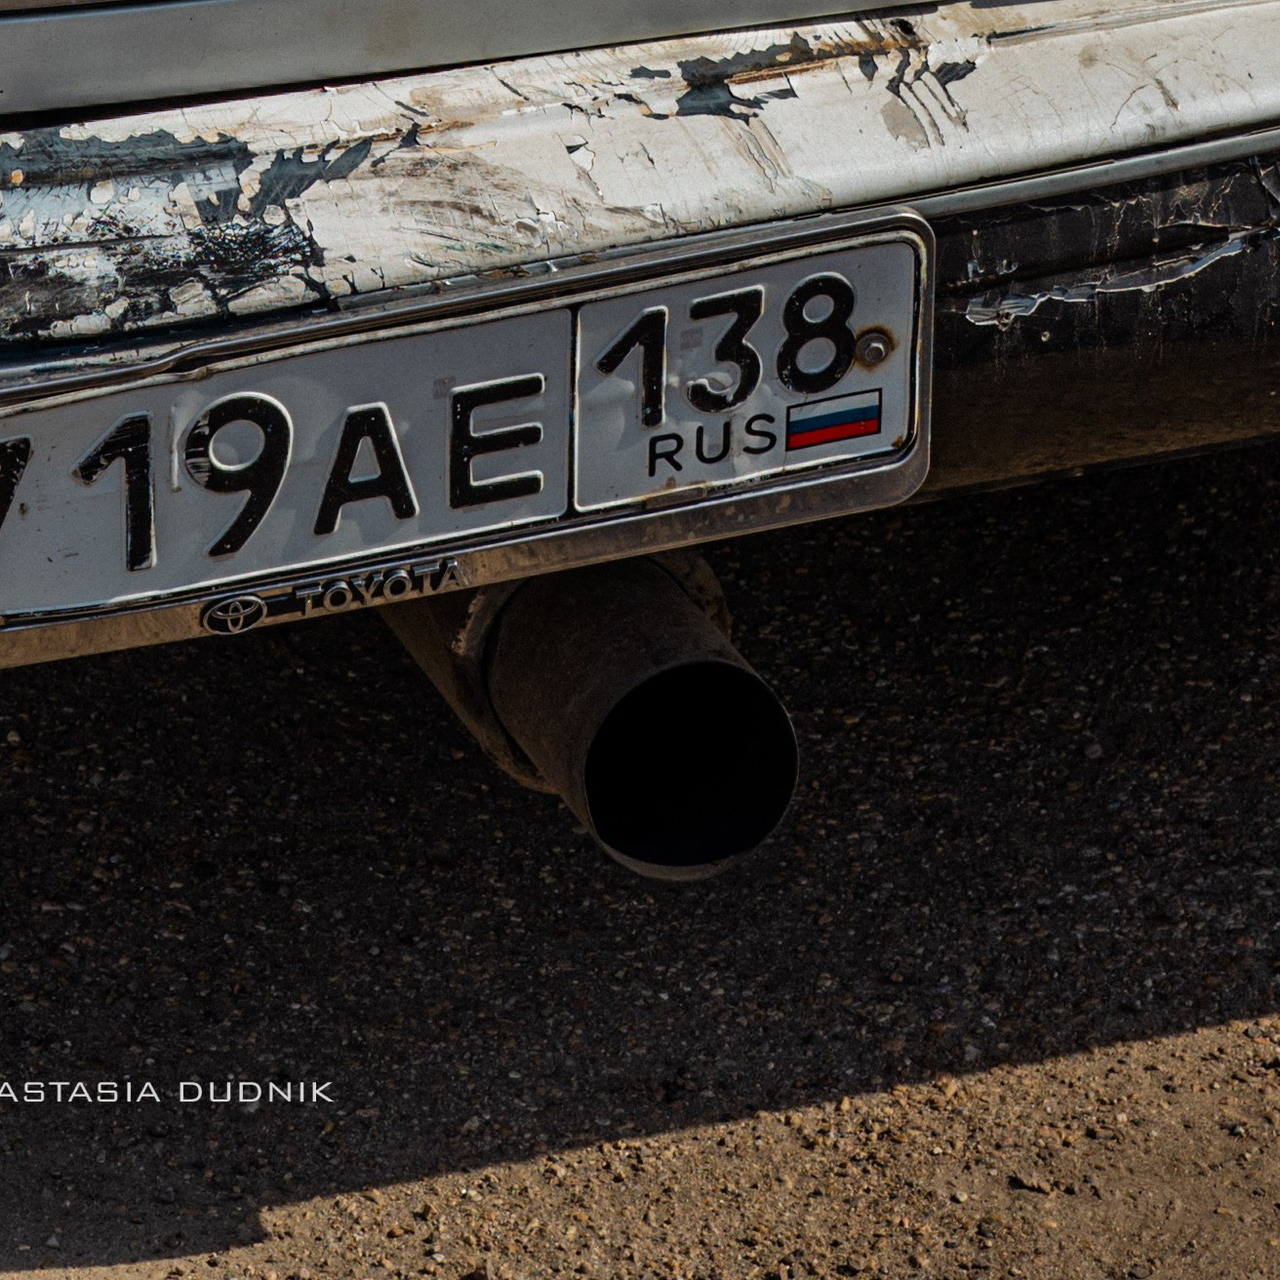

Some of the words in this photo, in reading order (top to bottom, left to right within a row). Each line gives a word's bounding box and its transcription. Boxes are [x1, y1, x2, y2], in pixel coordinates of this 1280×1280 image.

[596, 271, 857, 427] 138
[648, 413, 777, 477] RUS
[295, 558, 470, 618] TOYOTA
